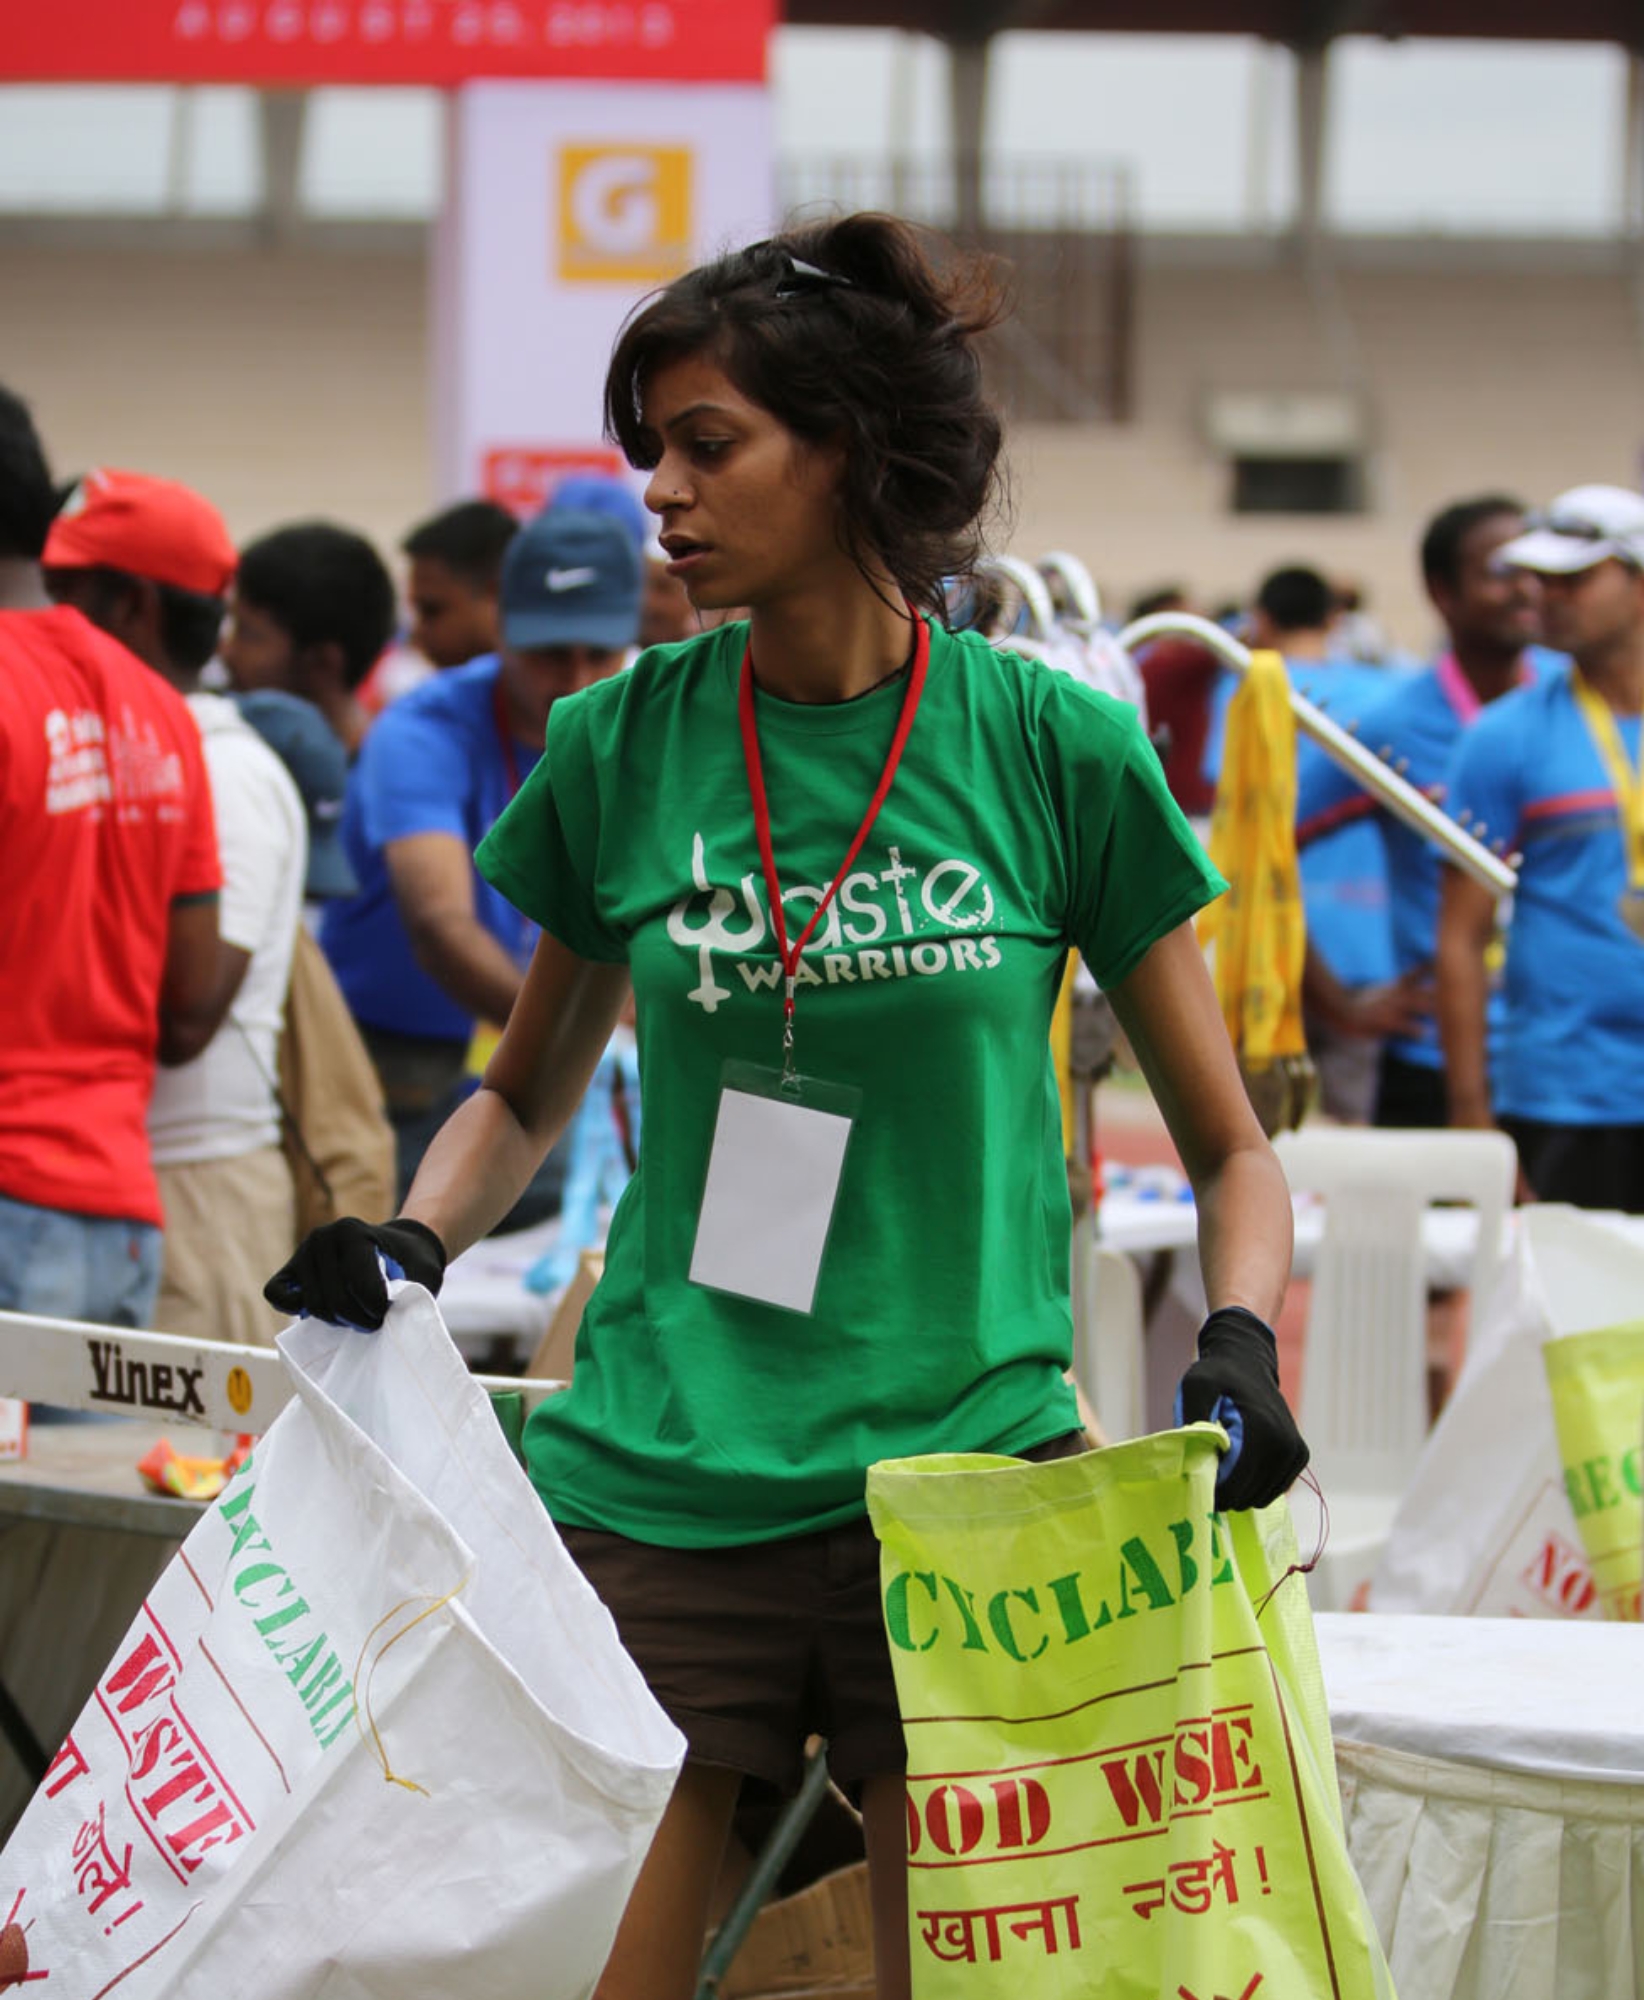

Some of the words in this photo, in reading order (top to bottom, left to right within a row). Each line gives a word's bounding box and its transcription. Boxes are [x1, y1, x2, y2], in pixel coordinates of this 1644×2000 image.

[736, 935, 1002, 993] WARRIORS
[87, 1340, 206, 1415] Vinex
[906, 1777, 1051, 1856] OD
[917, 1895, 1081, 1963] खाना
